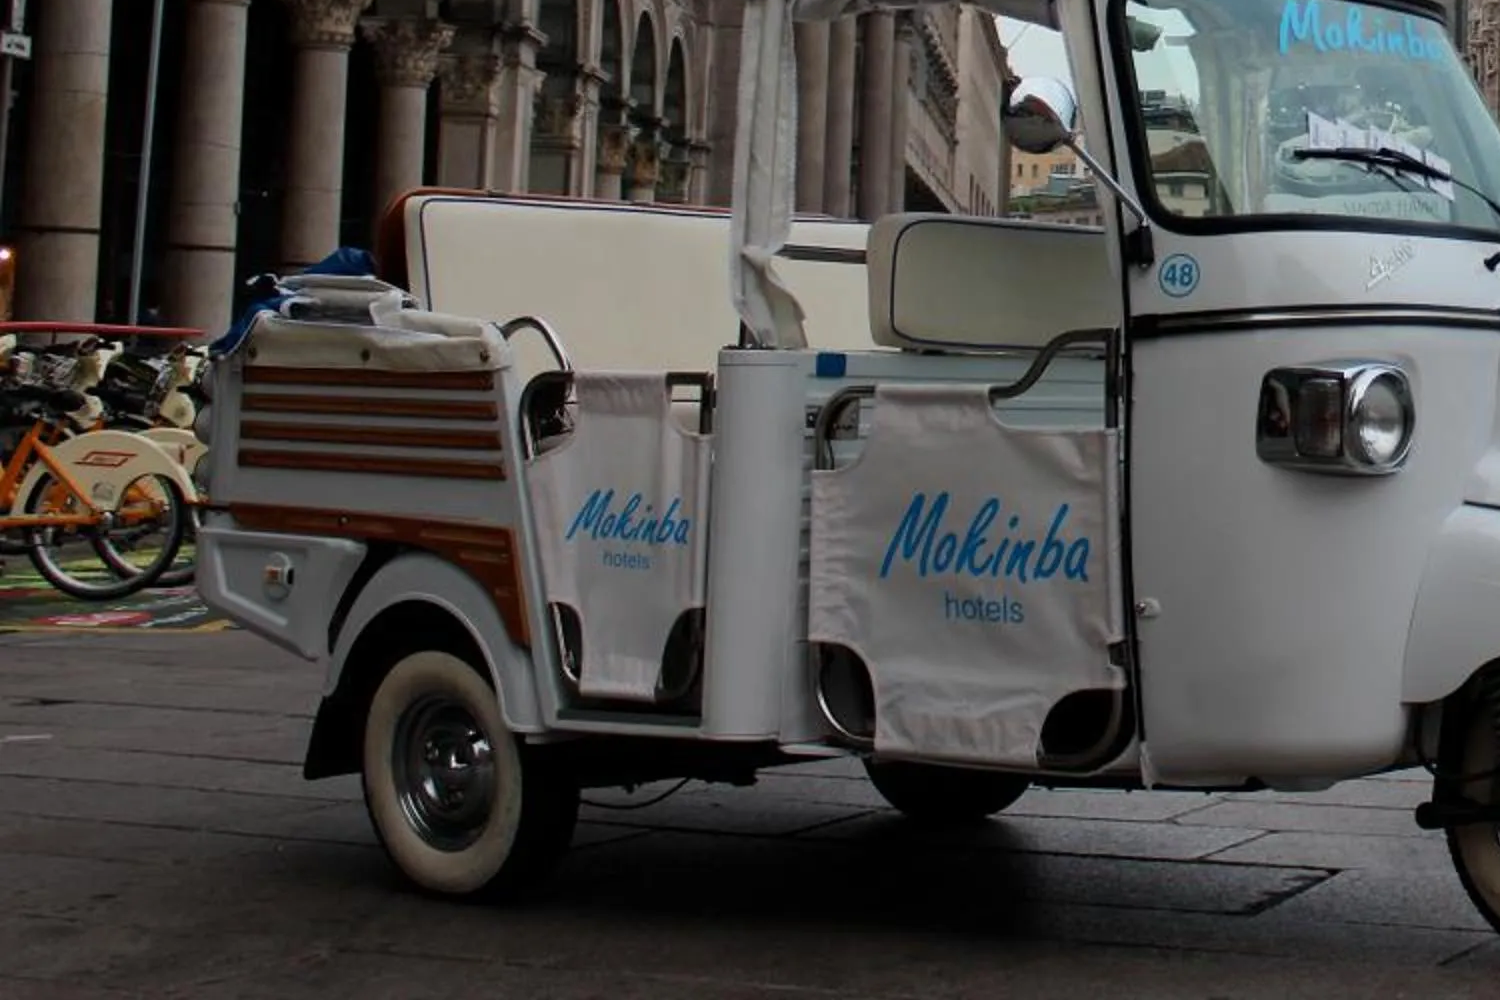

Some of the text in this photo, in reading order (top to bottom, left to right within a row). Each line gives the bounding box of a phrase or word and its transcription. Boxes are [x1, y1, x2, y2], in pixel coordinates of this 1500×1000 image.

[1163, 263, 1193, 287] 48
[565, 488, 690, 545] Mokinba
[879, 491, 1090, 584] Mokinba
[602, 551, 651, 570] hotels
[945, 590, 1025, 624] hotels
